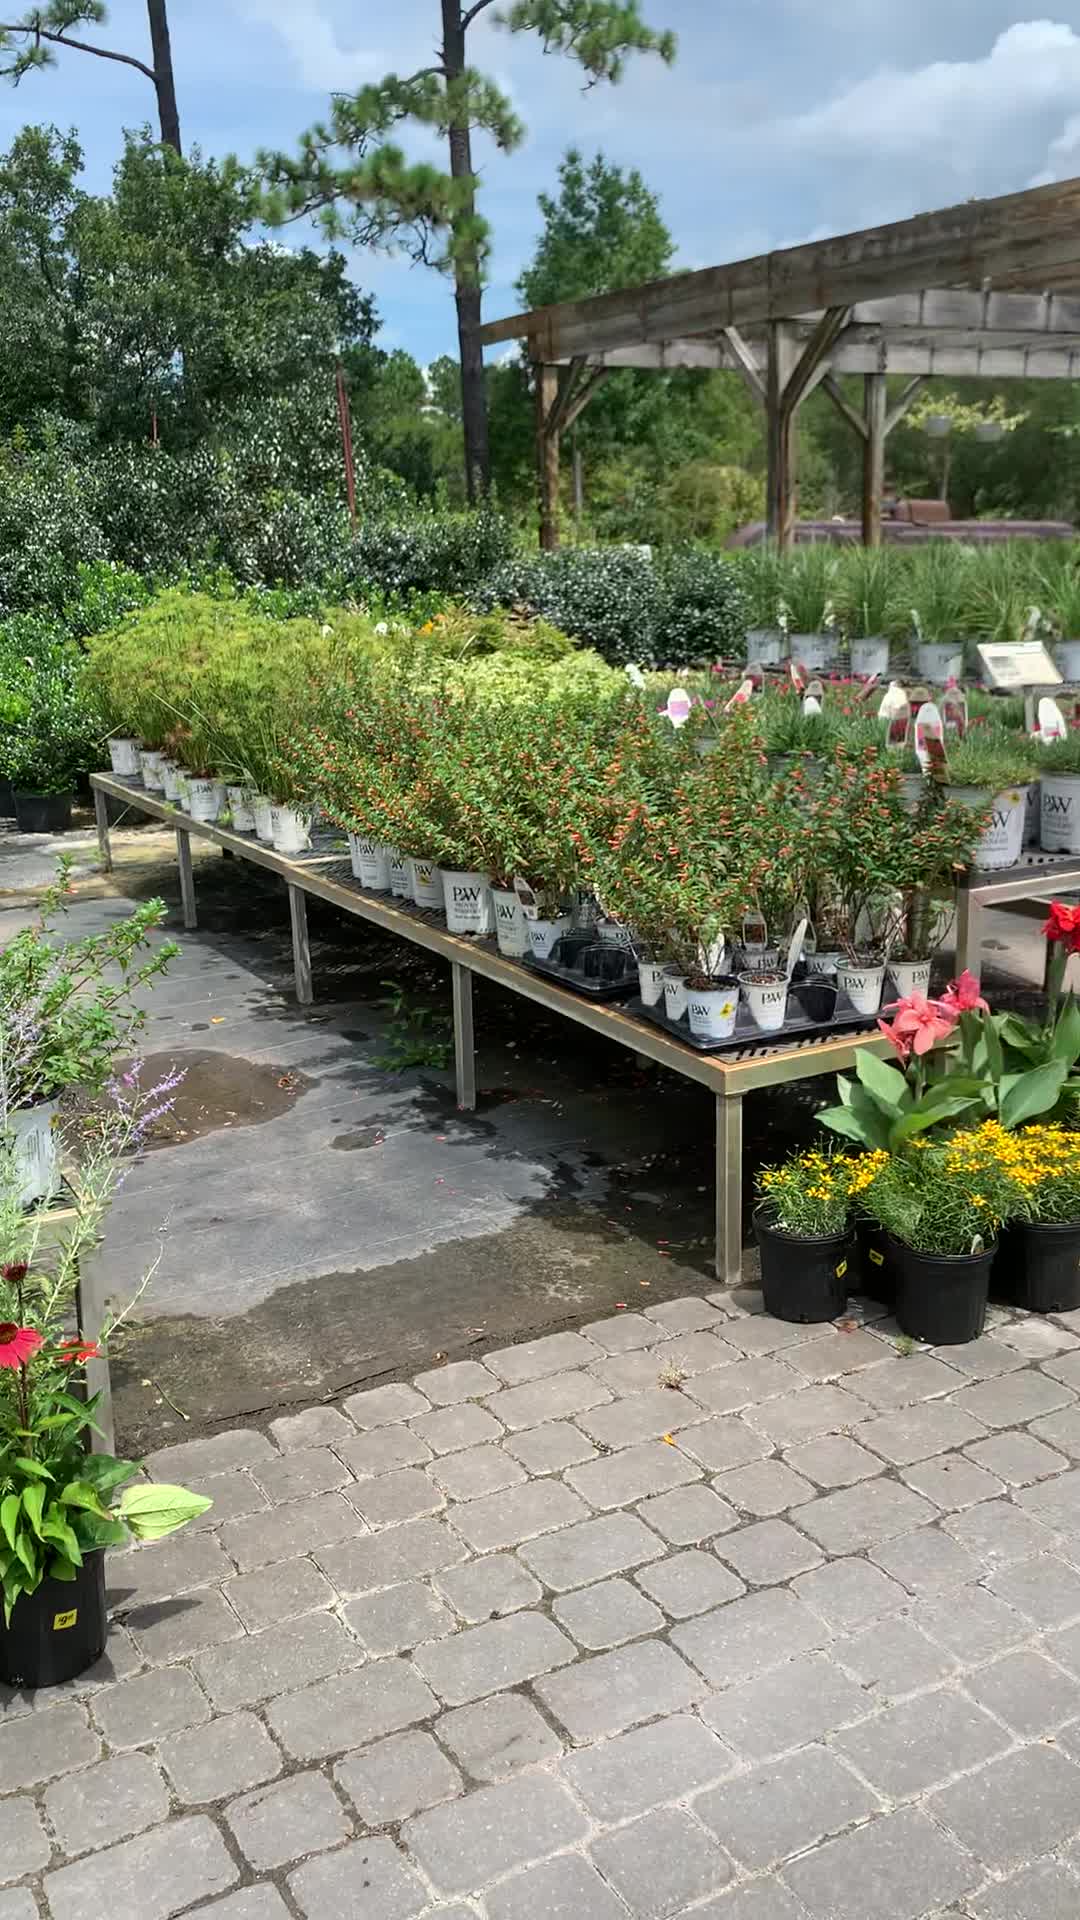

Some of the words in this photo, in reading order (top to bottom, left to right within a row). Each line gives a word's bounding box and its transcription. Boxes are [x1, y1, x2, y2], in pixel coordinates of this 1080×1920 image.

[1043, 793, 1073, 813] PW
[991, 808, 1013, 828] W
[414, 863, 433, 876] PW
[453, 887, 481, 902] PW
[496, 904, 515, 919] PW
[844, 976, 867, 989] PW
[761, 991, 783, 1004] PW
[691, 1003, 711, 1016] PW
